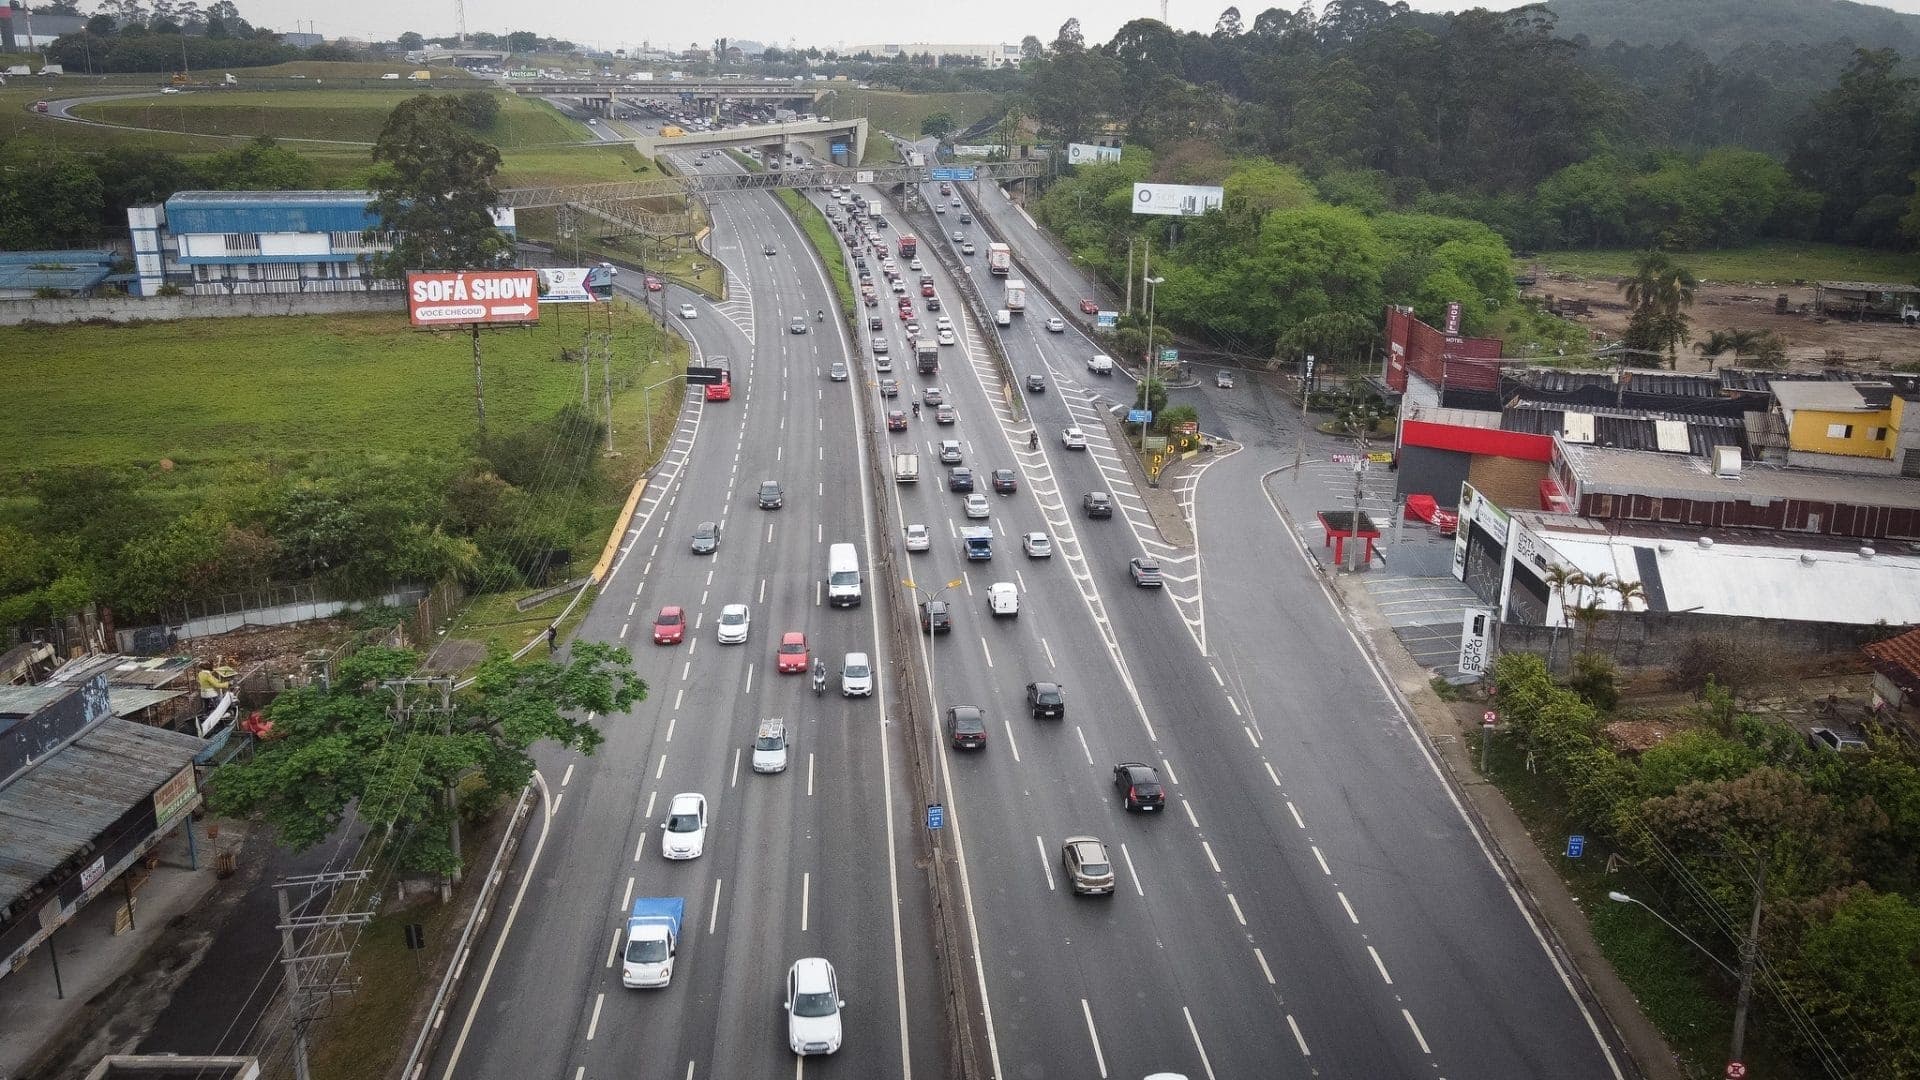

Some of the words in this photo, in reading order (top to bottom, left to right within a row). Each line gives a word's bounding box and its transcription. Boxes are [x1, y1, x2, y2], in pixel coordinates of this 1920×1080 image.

[413, 274, 468, 303] SOFÁ
[471, 277, 533, 300] SHOW
[444, 308, 482, 316] CHEGOU!
[1449, 304, 1459, 330] MOTEL
[1306, 354, 1315, 382] MOTE
